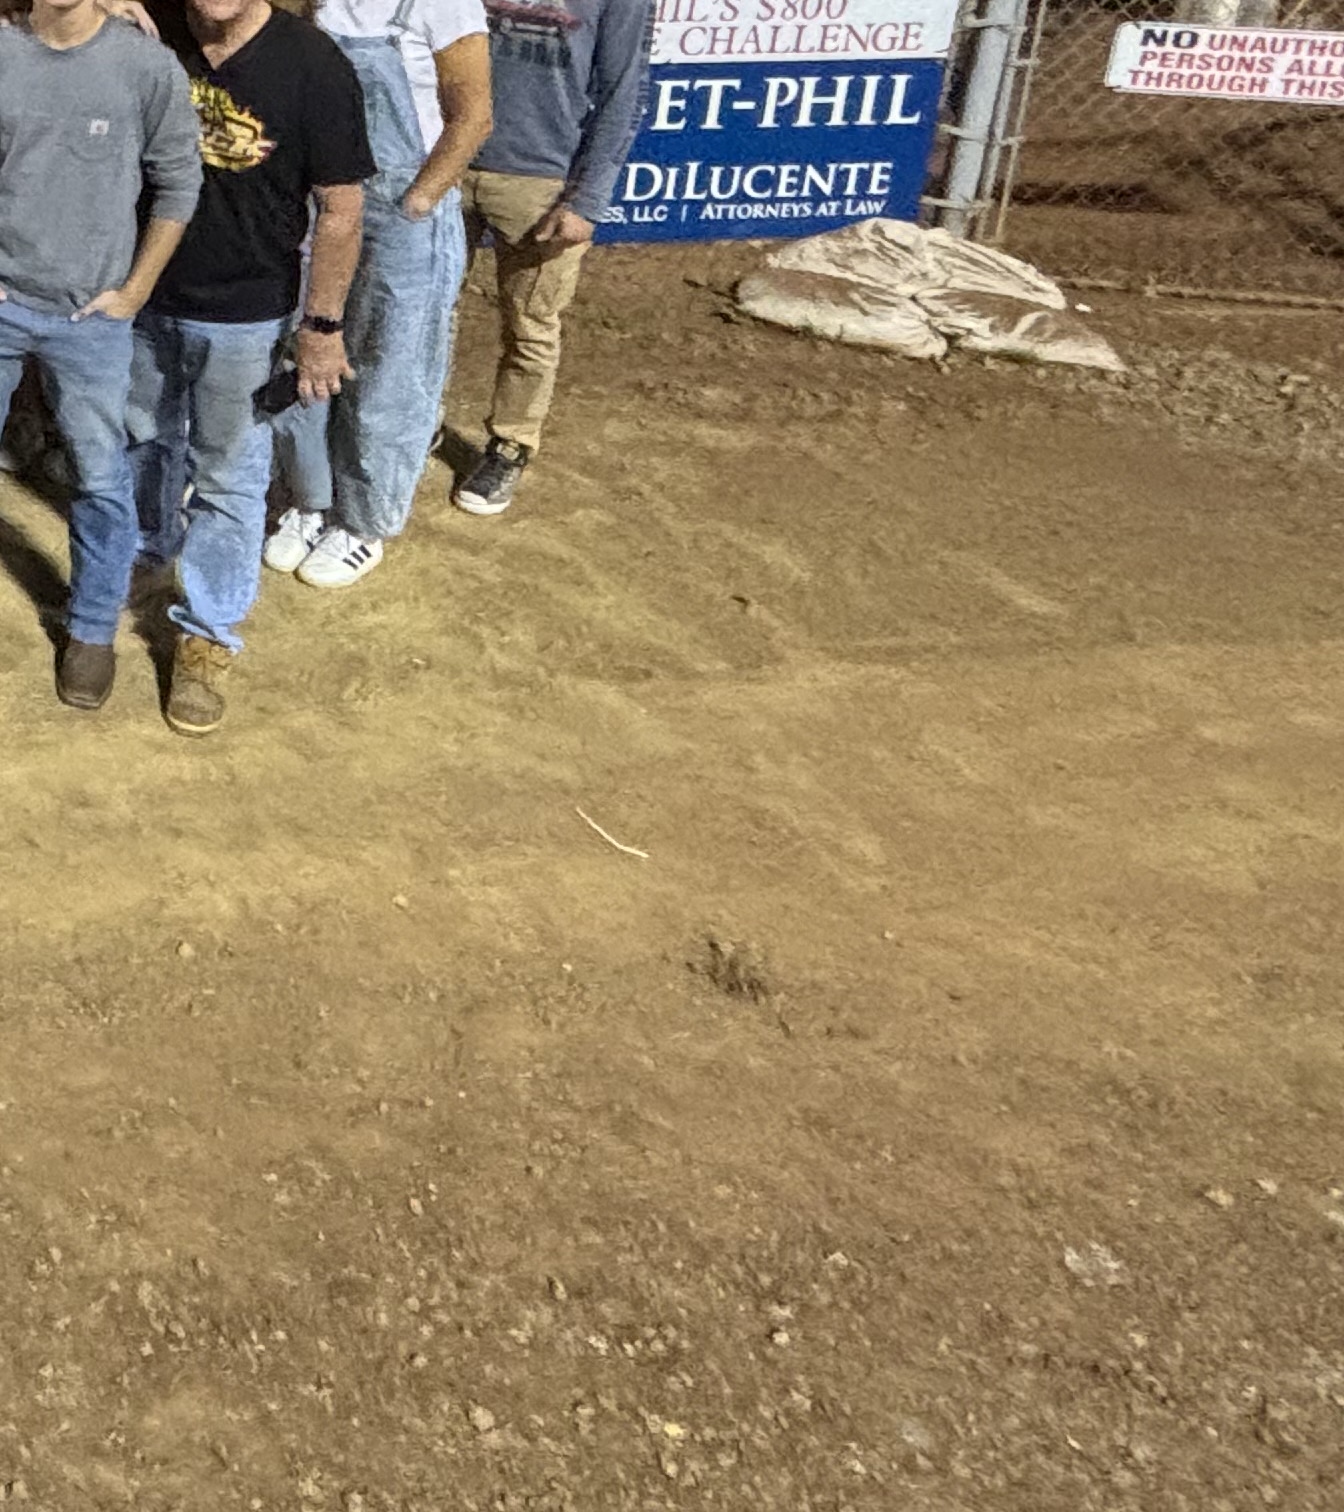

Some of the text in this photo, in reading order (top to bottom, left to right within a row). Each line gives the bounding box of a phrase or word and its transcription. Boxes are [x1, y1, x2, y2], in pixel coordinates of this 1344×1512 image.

[679, 22, 924, 57] CHALLENGE
[1140, 29, 1199, 50] NO
[1138, 50, 1344, 78] PERSONS ALL
[1129, 69, 1344, 99] THROUGH THIS
[644, 74, 921, 131] ET-PHIL
[632, 207, 668, 222] LLC
[699, 202, 811, 220] ATTORNEYS
[816, 201, 843, 217] AT
[844, 198, 887, 217] LAW
